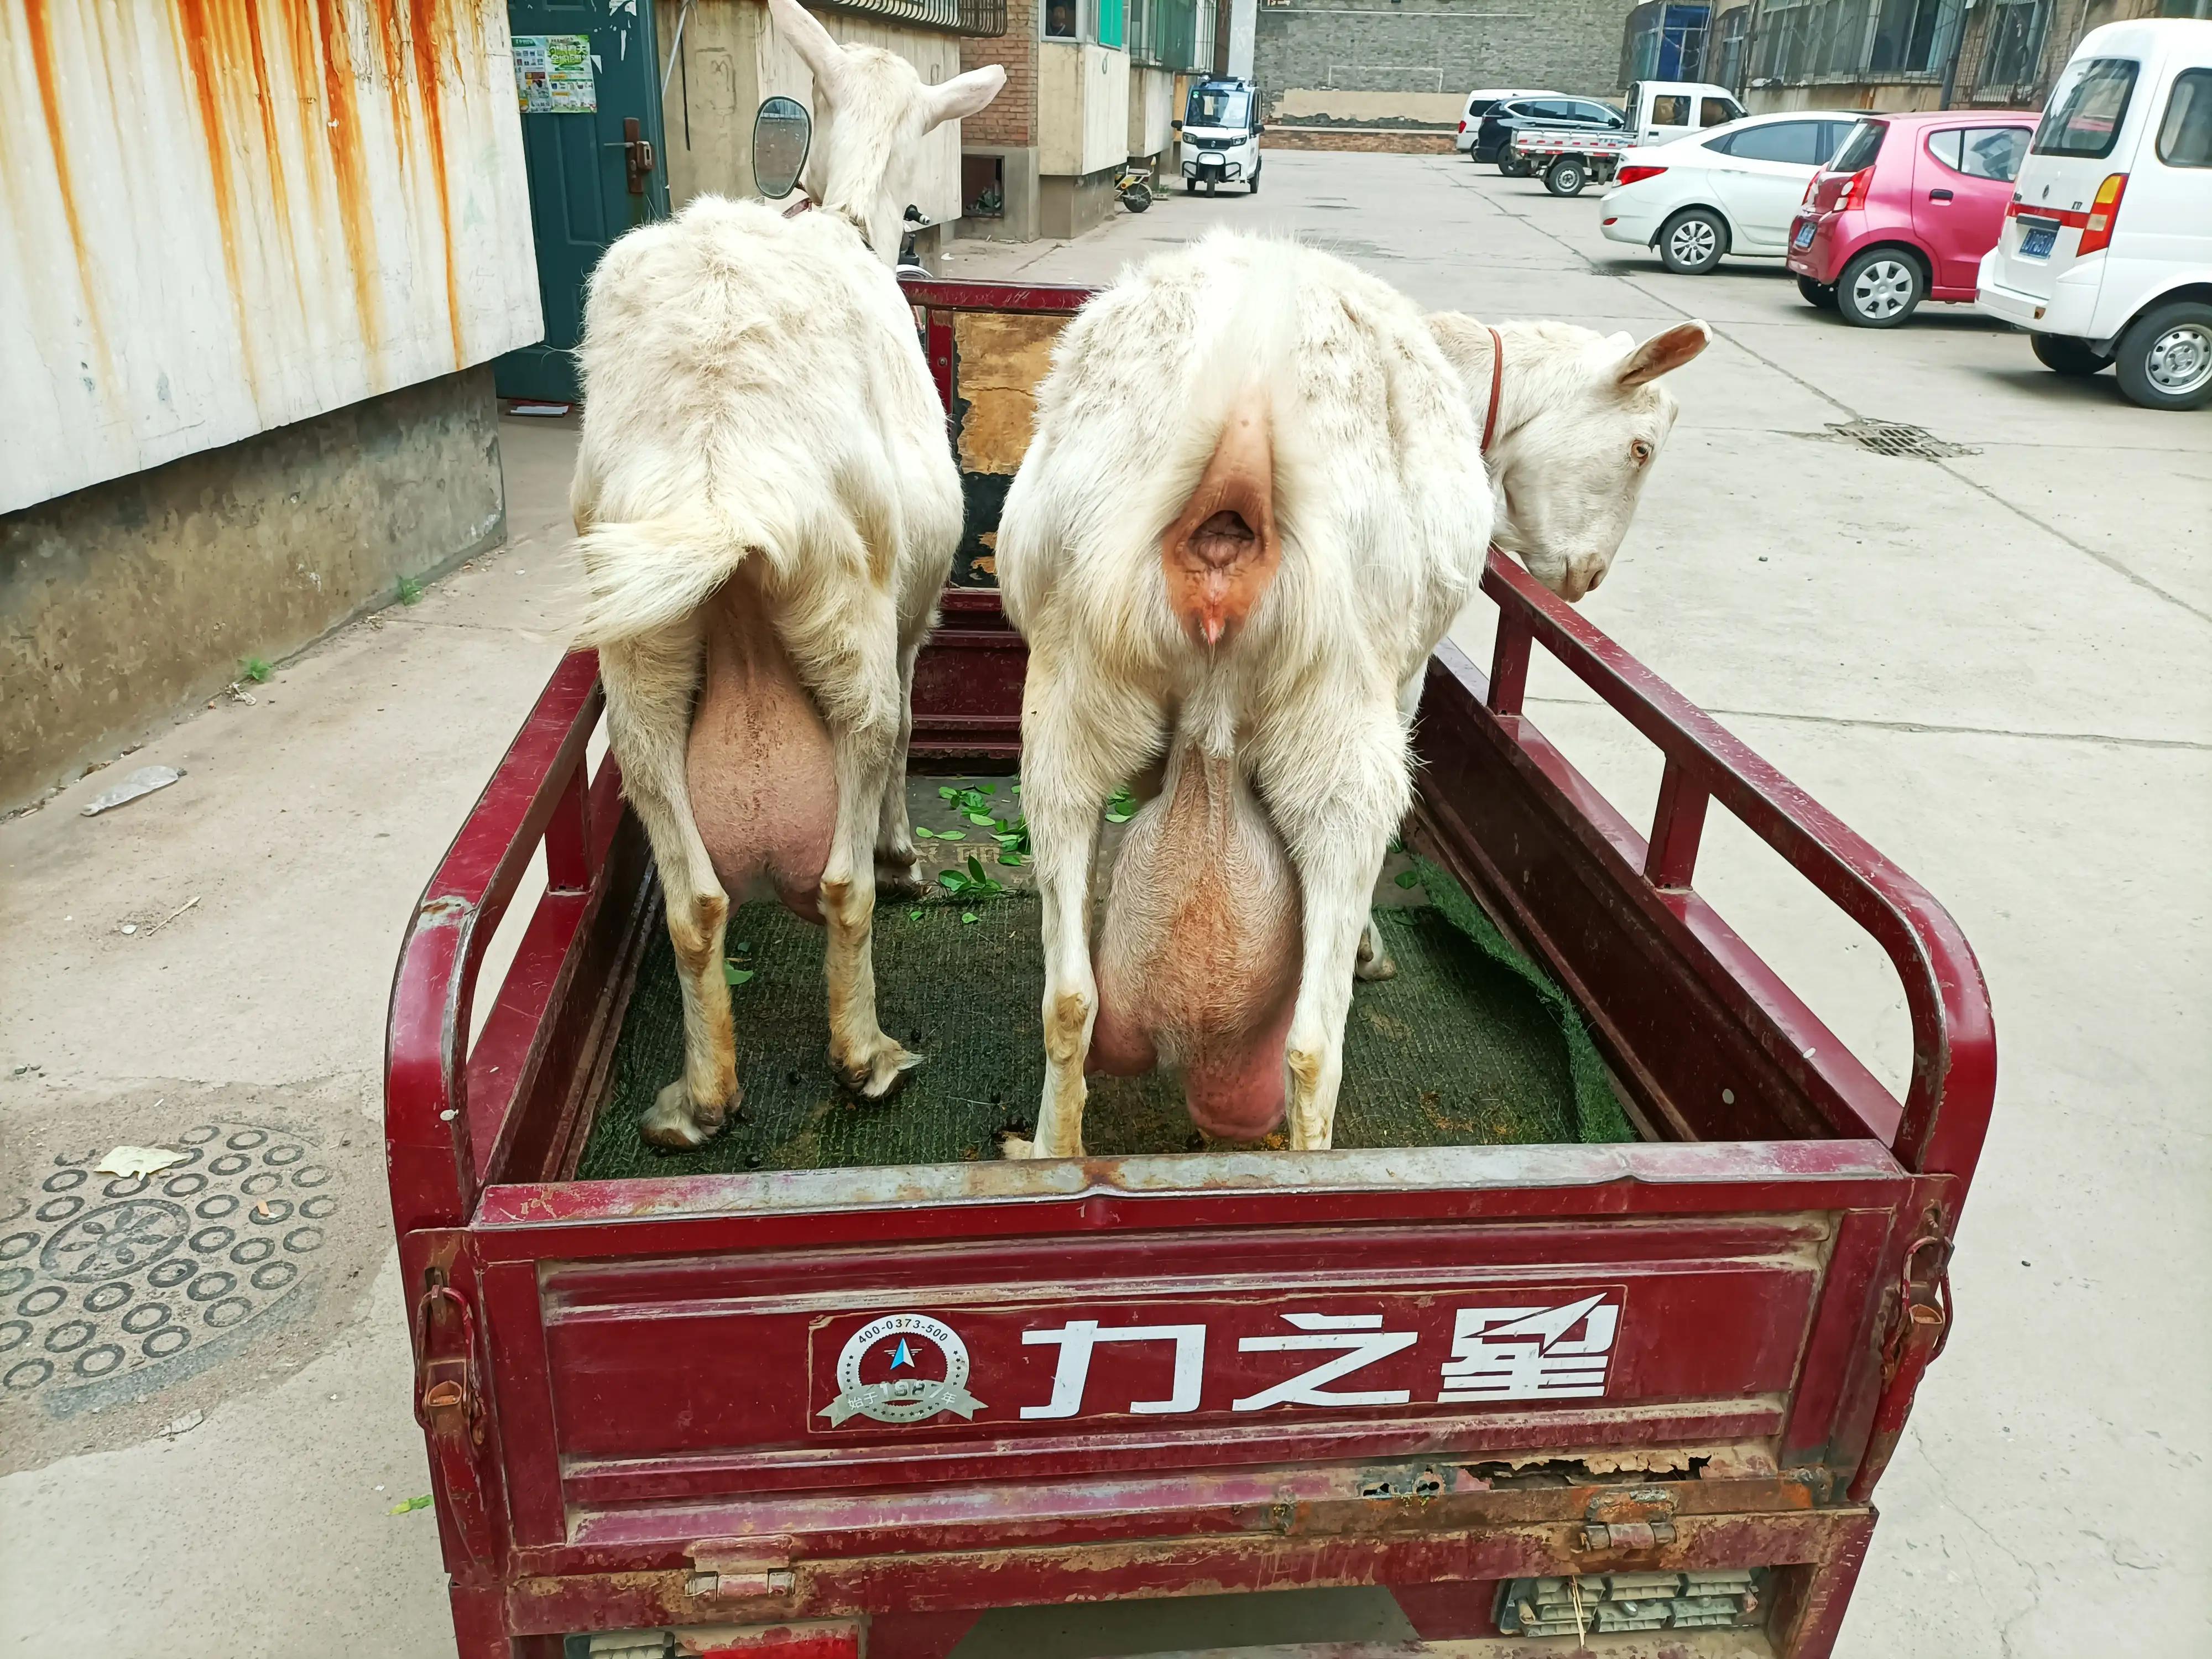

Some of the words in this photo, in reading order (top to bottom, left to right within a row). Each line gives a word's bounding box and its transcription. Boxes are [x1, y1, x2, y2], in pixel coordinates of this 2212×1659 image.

[858, 1318, 948, 1344] 400-0373-500
[1019, 1292, 1619, 1420] 力之星
